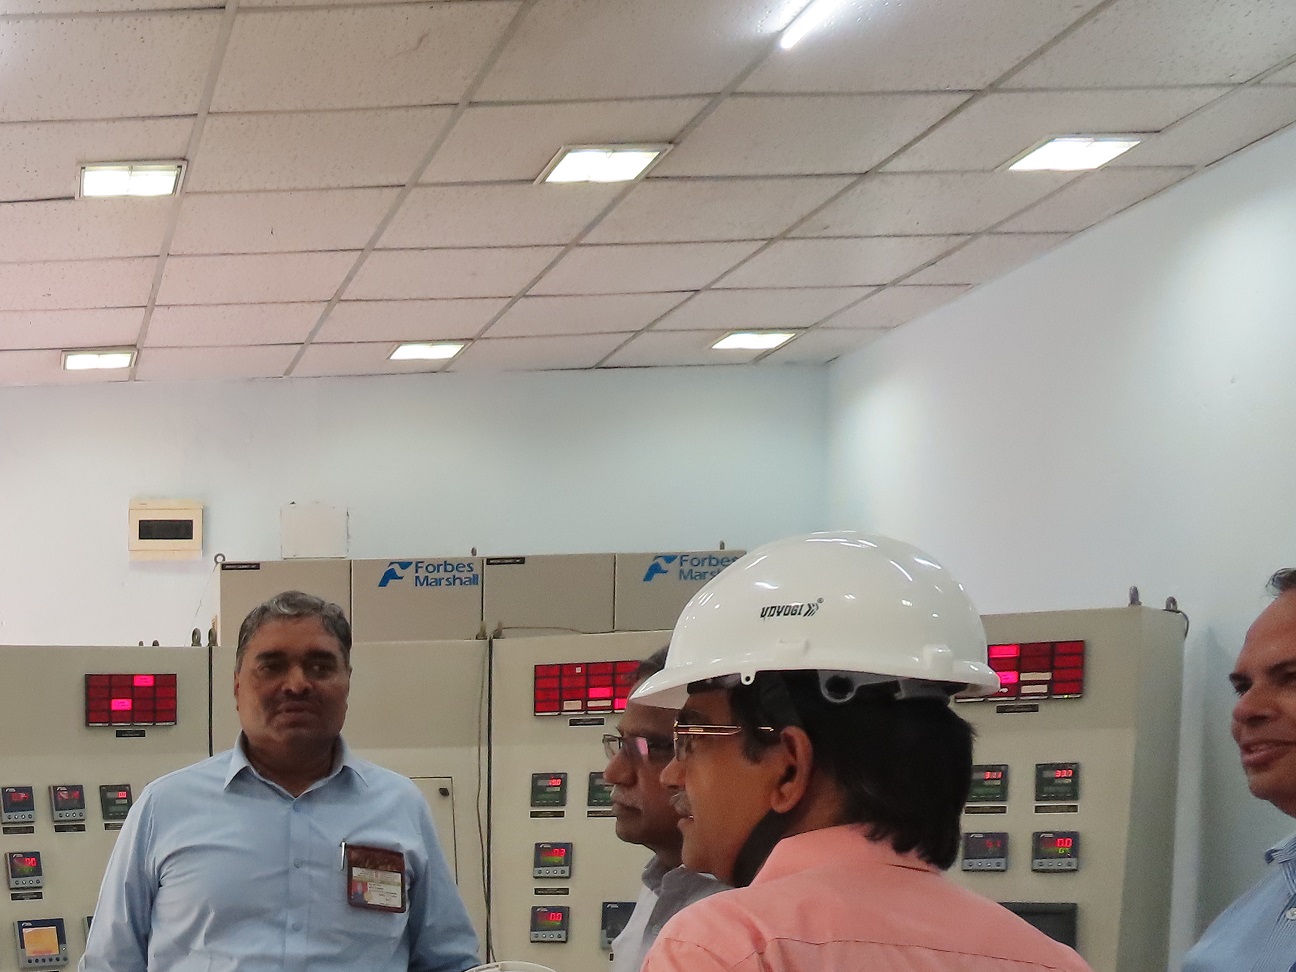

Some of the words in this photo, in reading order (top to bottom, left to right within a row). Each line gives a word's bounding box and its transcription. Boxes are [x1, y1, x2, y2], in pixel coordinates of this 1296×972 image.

[415, 560, 474, 574] Forbes
[415, 574, 479, 587] Marshall
[760, 603, 805, 619] UDYOGI
